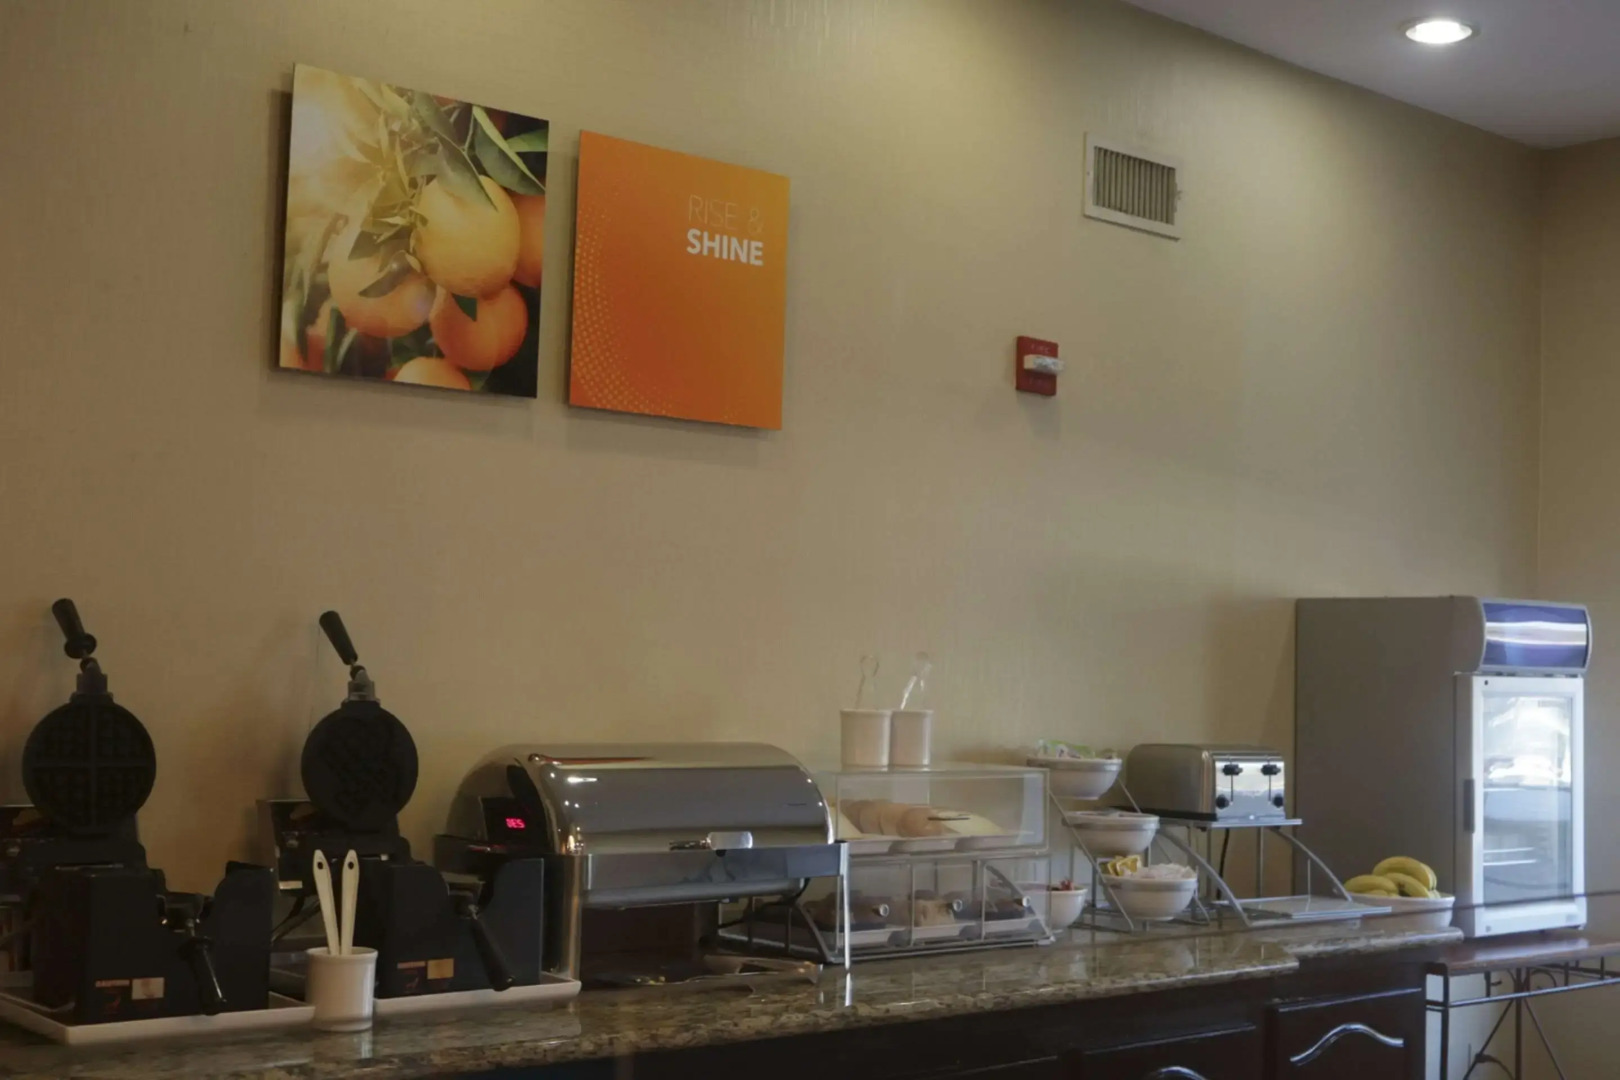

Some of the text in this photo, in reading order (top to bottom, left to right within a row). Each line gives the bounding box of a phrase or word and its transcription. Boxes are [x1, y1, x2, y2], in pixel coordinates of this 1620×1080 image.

[688, 194, 764, 236] RISE &
[686, 228, 764, 266] SHINE
